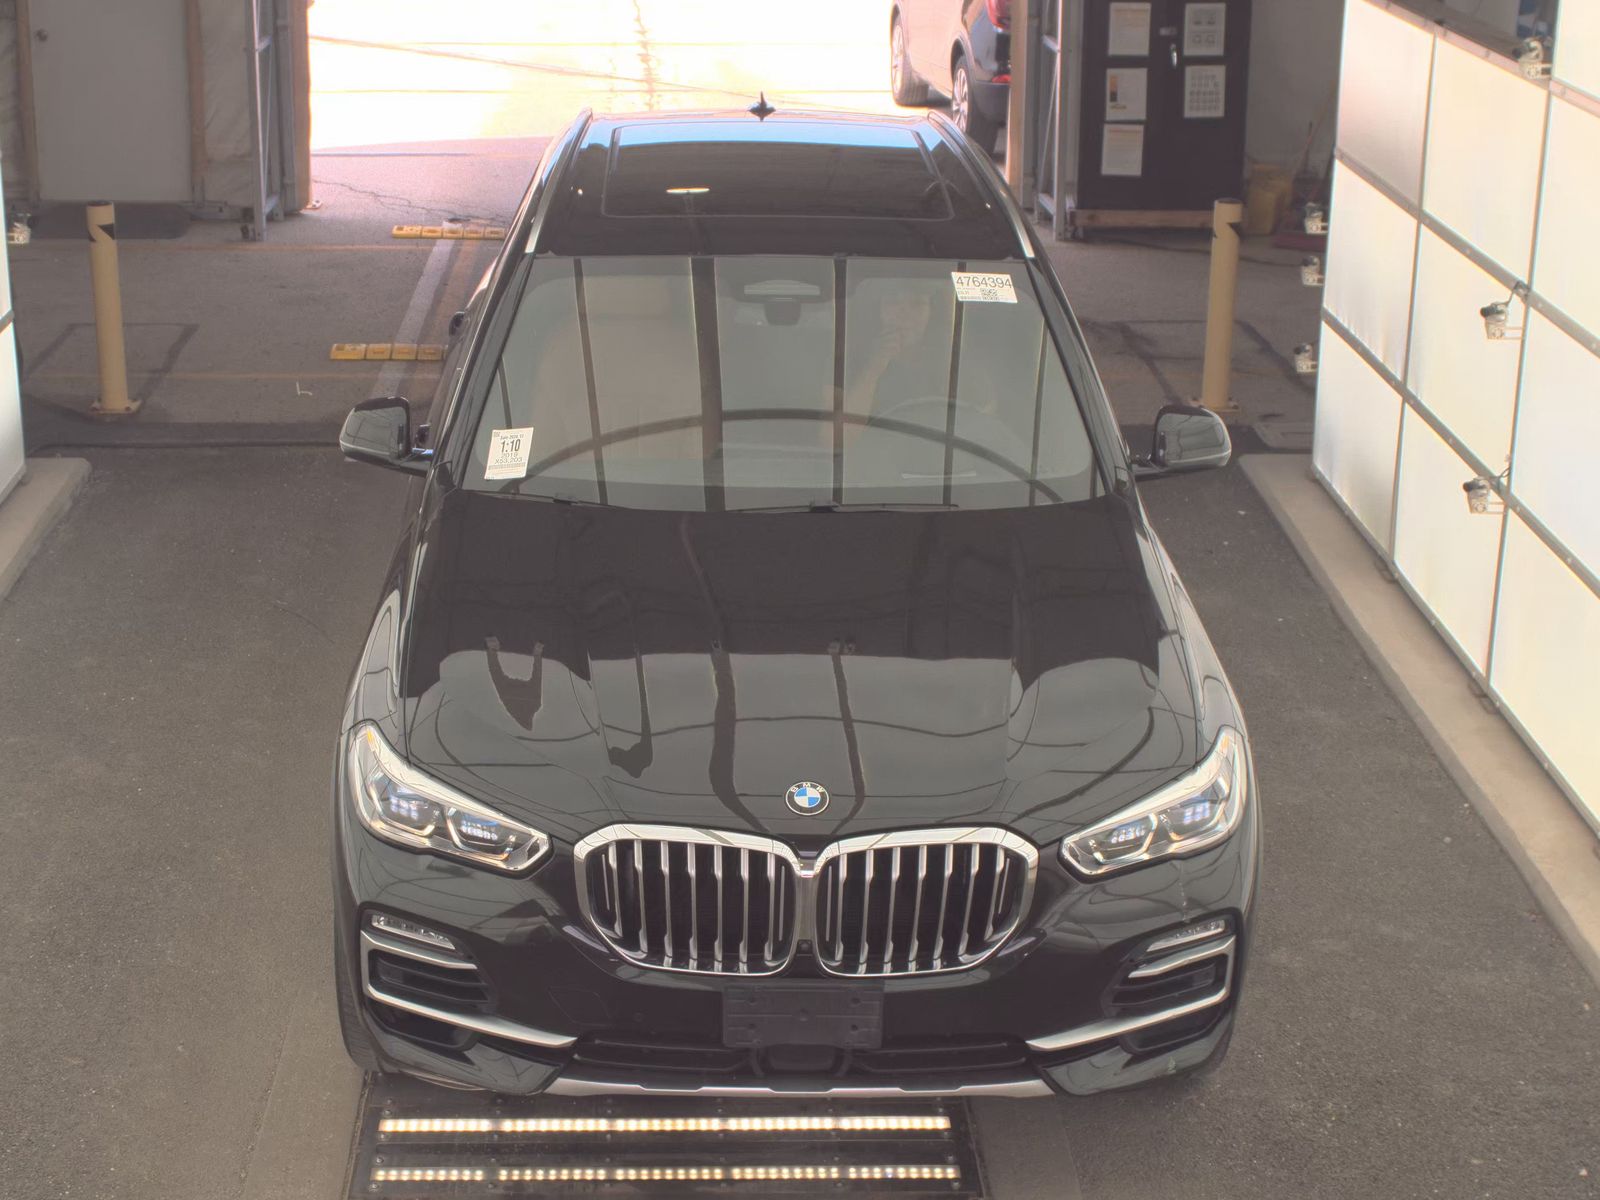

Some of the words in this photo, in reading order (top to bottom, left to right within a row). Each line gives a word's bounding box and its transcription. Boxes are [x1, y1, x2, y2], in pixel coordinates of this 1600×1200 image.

[956, 276, 1012, 289] 4764394
[501, 439, 521, 453] 1:10
[790, 782, 825, 793] BMW
